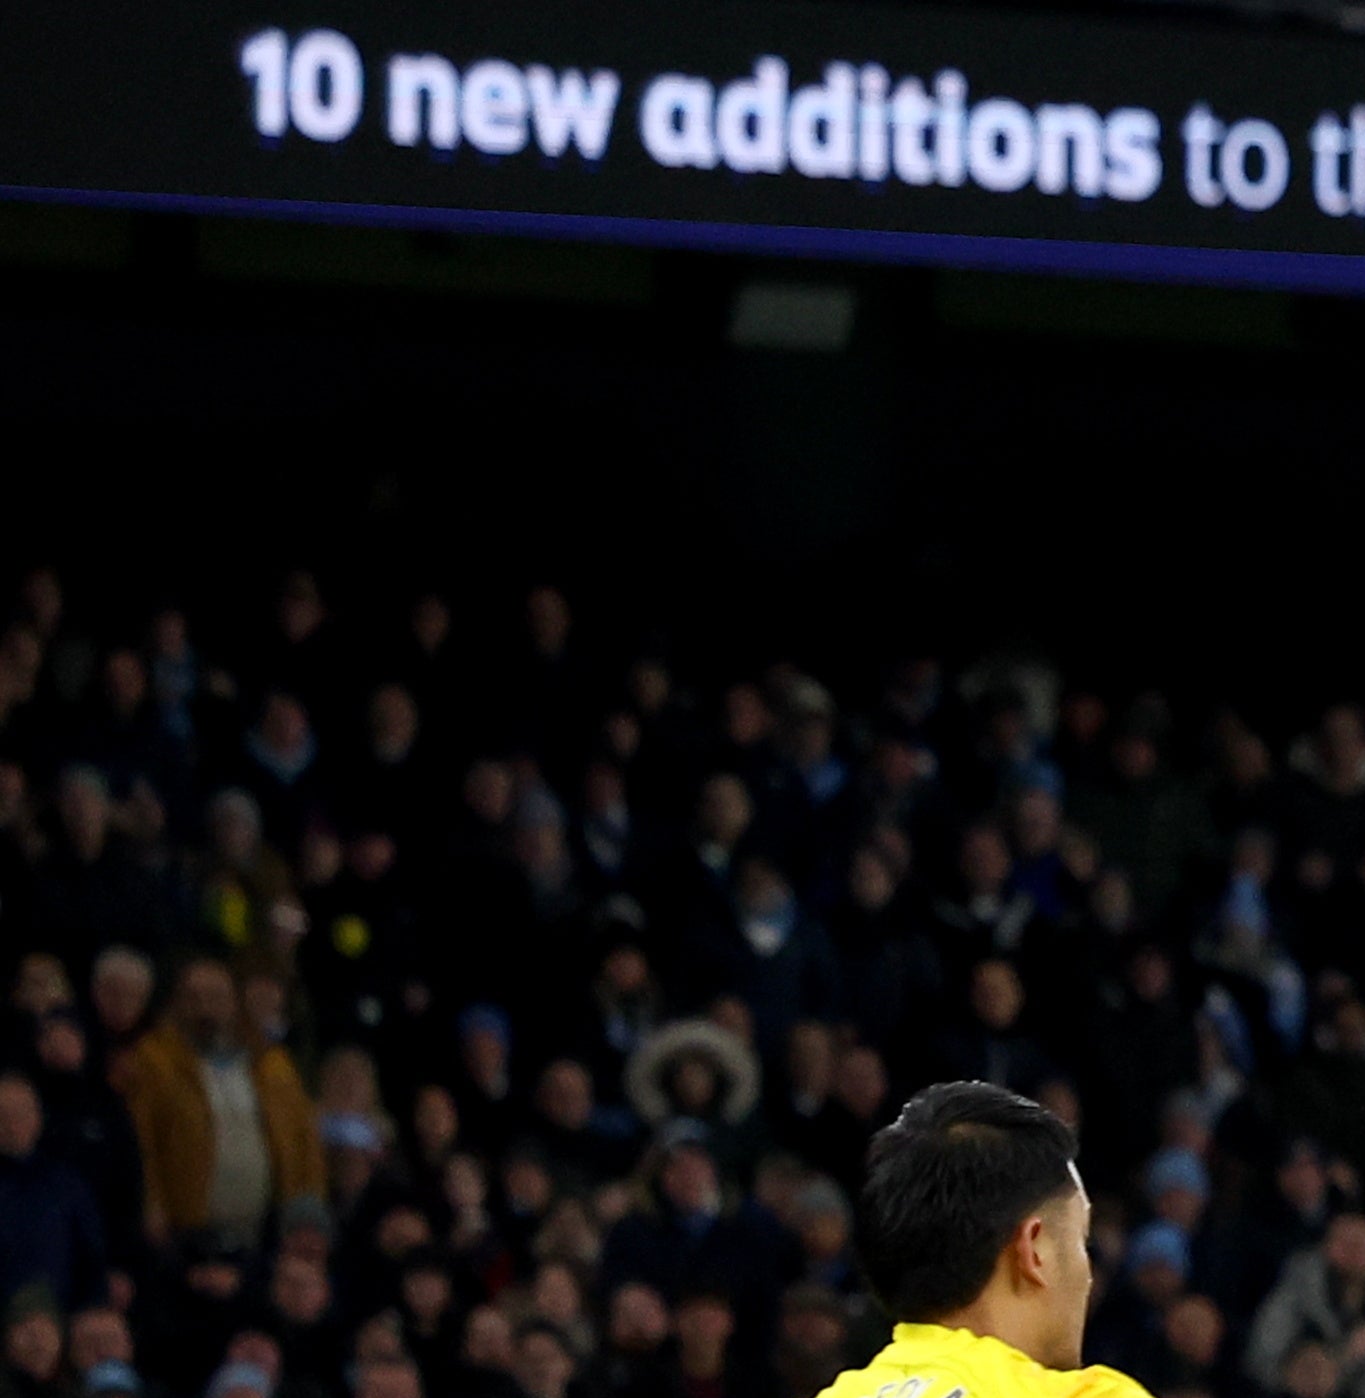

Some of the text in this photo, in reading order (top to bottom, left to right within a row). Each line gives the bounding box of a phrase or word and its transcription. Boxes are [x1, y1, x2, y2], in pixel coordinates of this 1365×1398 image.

[240, 29, 363, 142] 10
[387, 53, 619, 160] new
[640, 56, 1163, 203] additions
[1182, 106, 1289, 211] to
